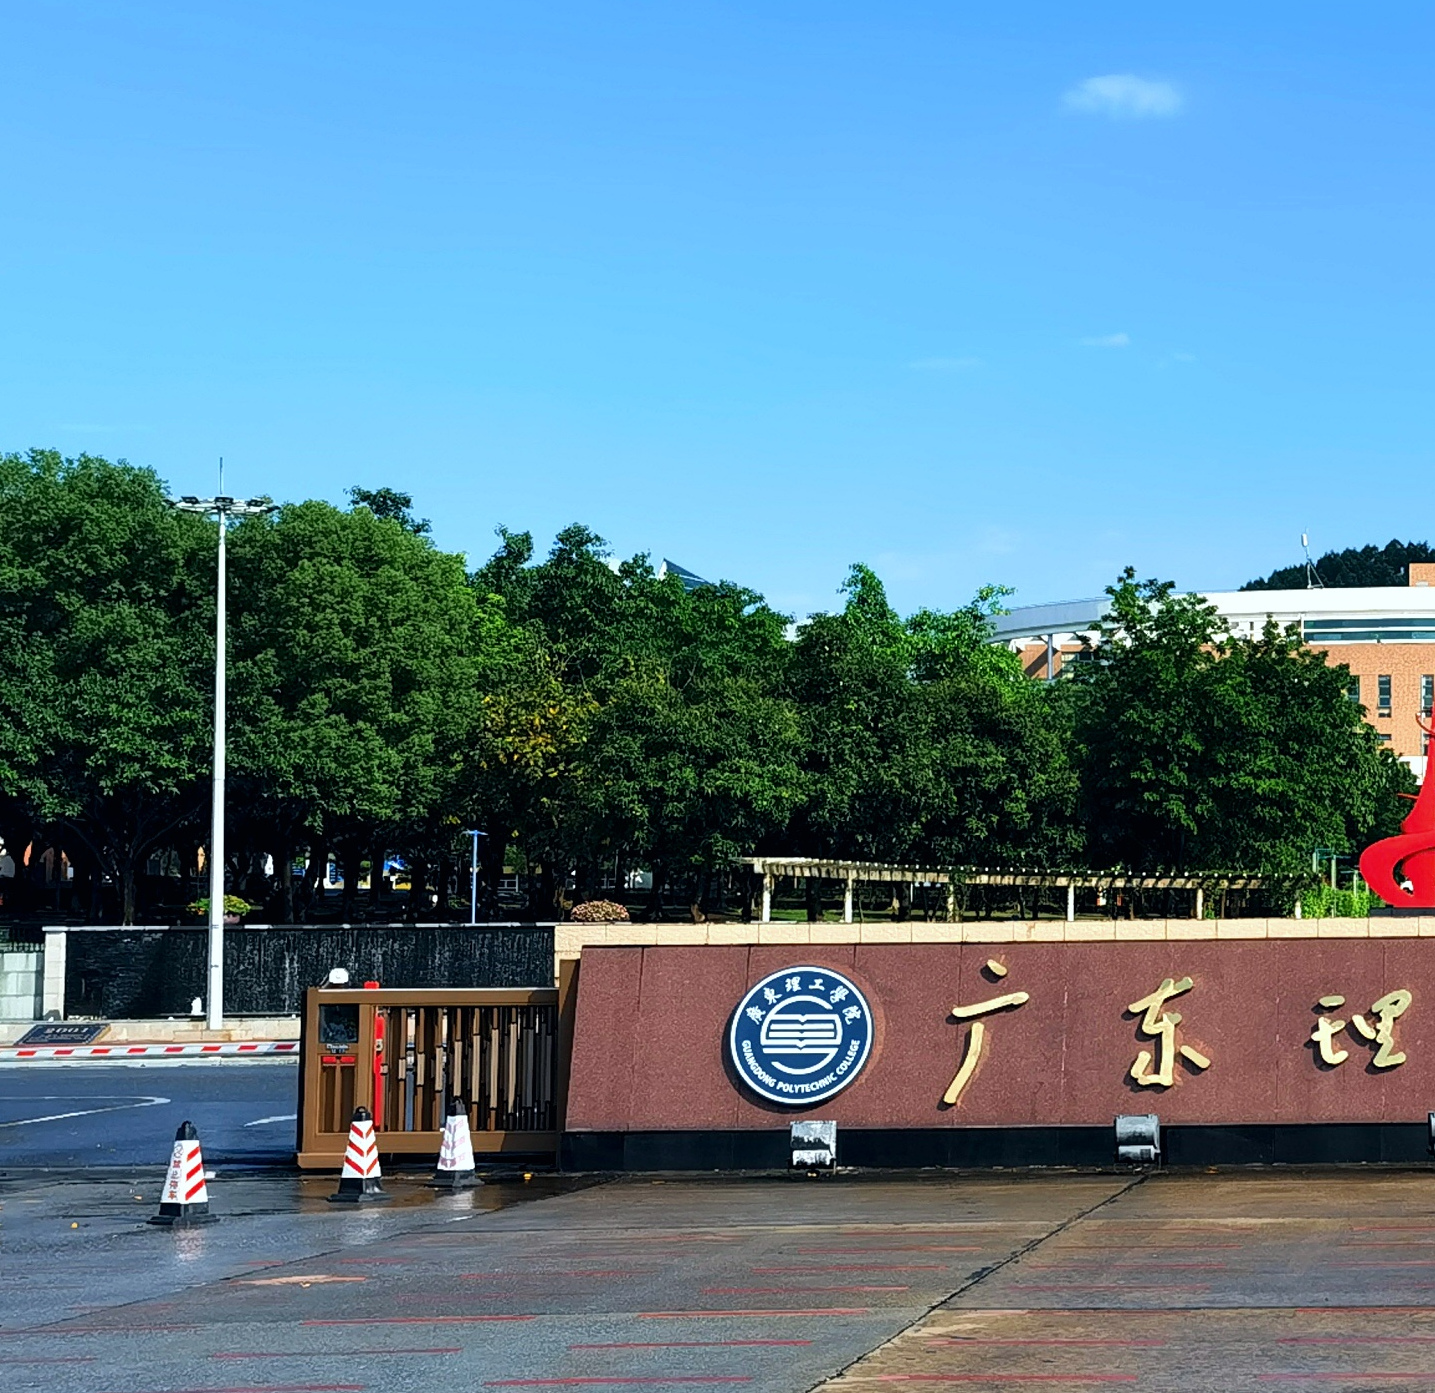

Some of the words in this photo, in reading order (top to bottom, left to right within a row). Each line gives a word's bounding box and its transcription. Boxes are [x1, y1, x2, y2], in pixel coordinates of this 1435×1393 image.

[745, 976, 862, 1026] 廣東理工學院
[741, 1039, 778, 1088] GUANGDONG
[776, 1072, 838, 1094] POLYTECHNIC
[835, 1039, 861, 1076] COLLEGE
